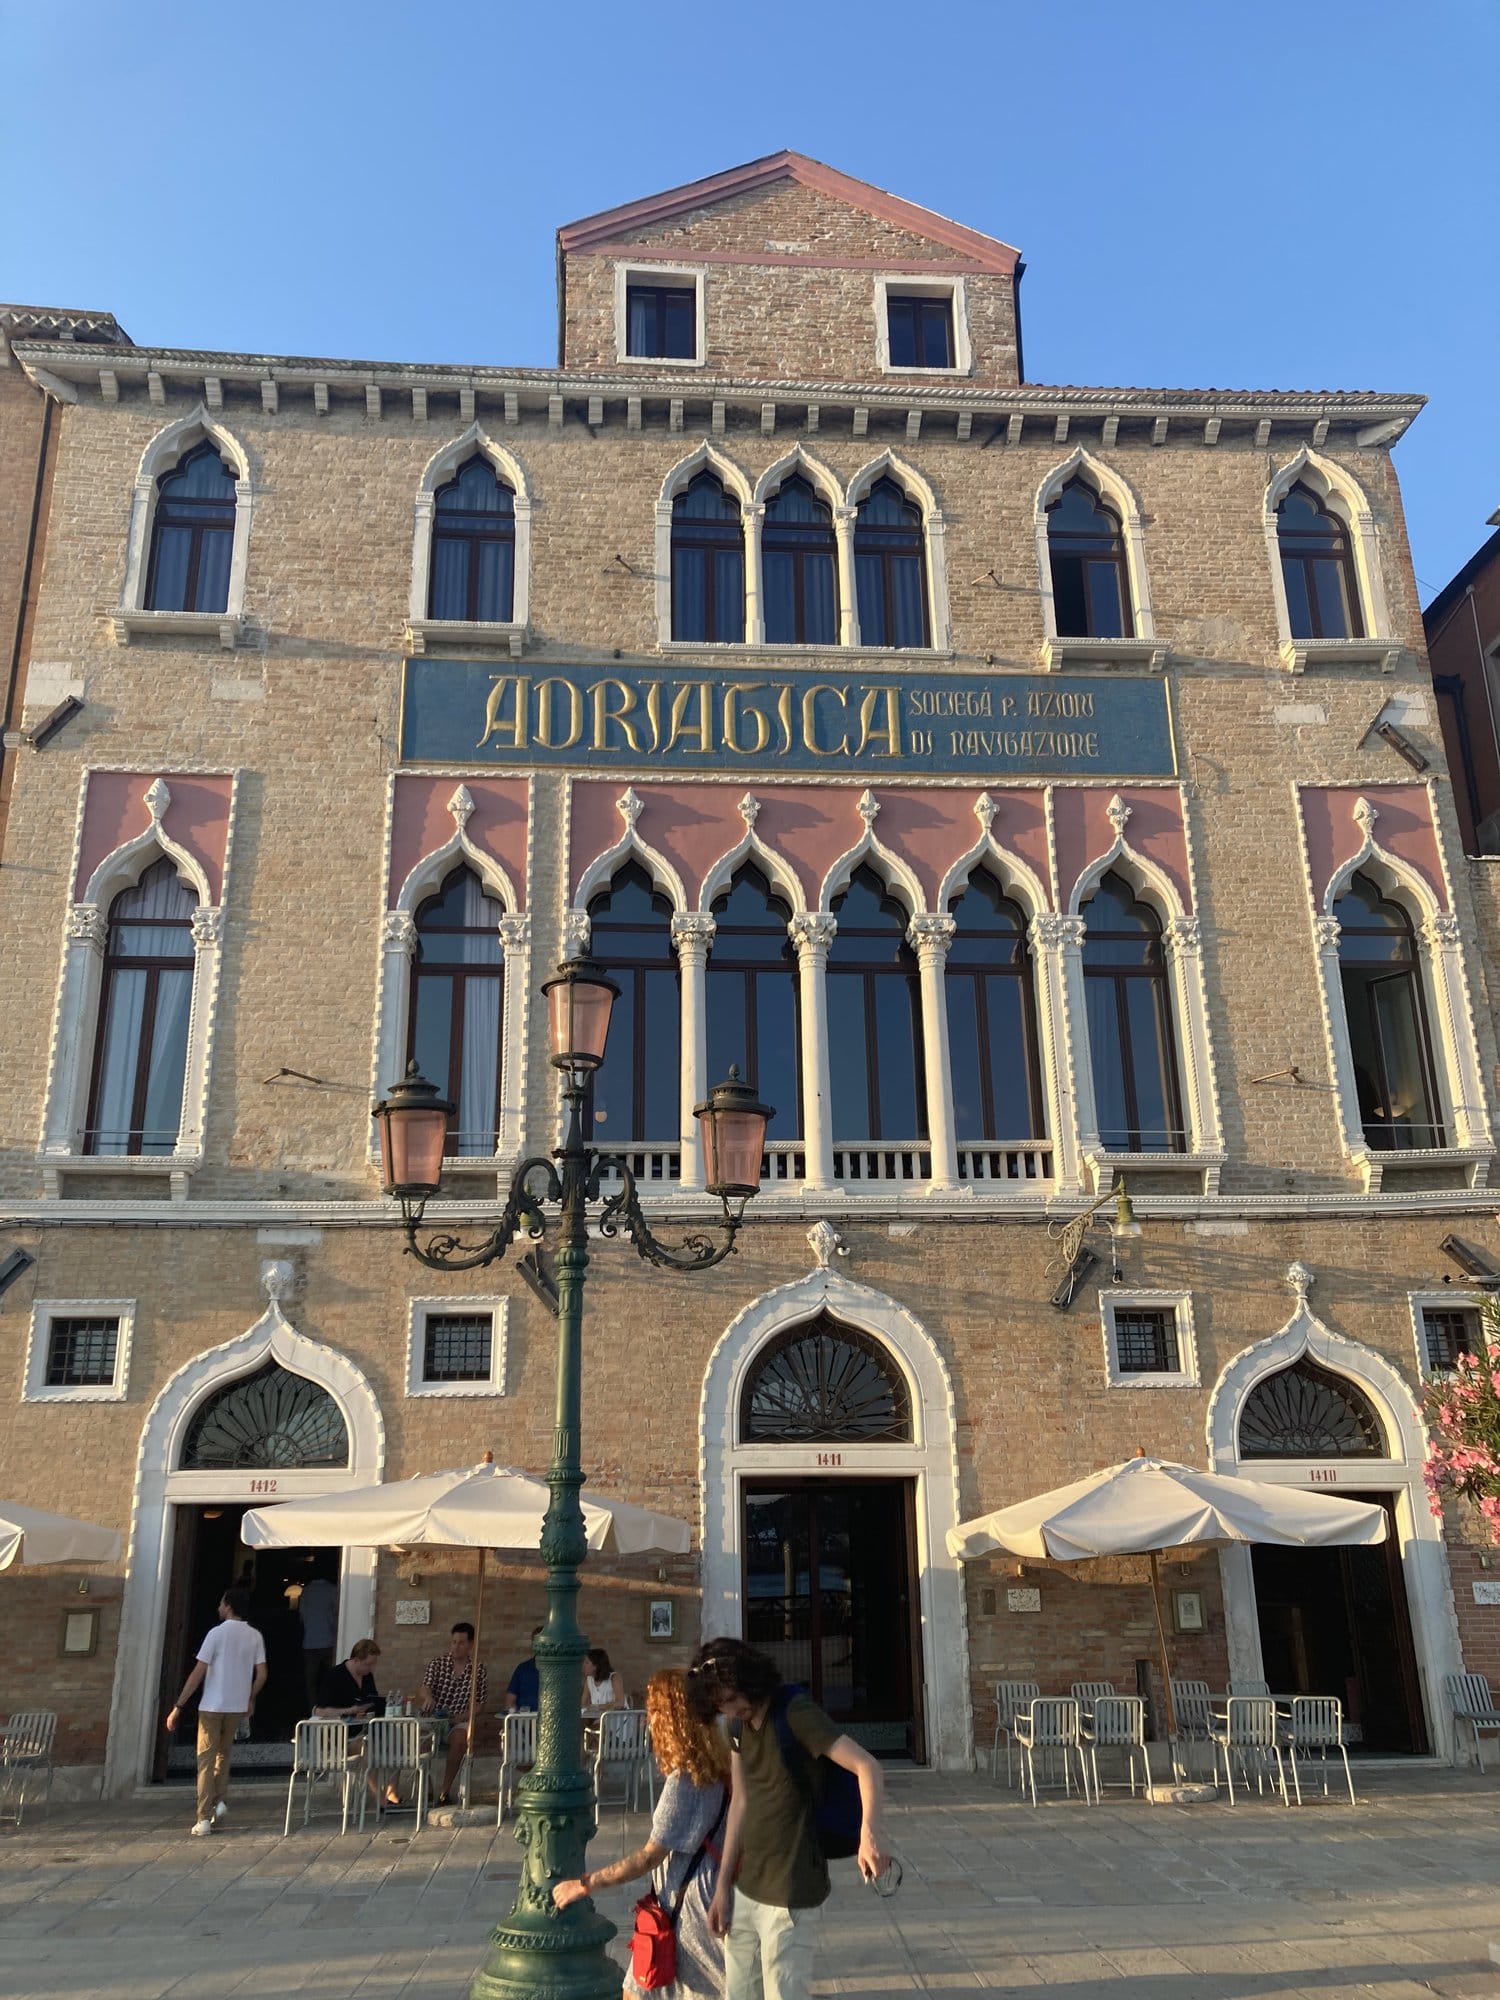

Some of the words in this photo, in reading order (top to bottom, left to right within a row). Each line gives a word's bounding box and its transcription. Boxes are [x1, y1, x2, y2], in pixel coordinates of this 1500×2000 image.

[1028, 691, 1095, 718] AZIONI
[476, 674, 905, 758] ADRIATICA
[911, 730, 933, 756] DI
[950, 730, 1100, 758] NAVIGAZIONE
[816, 1453, 841, 1466] 1411
[1309, 1469, 1336, 1481] 1410
[250, 1479, 277, 1492] 1412
